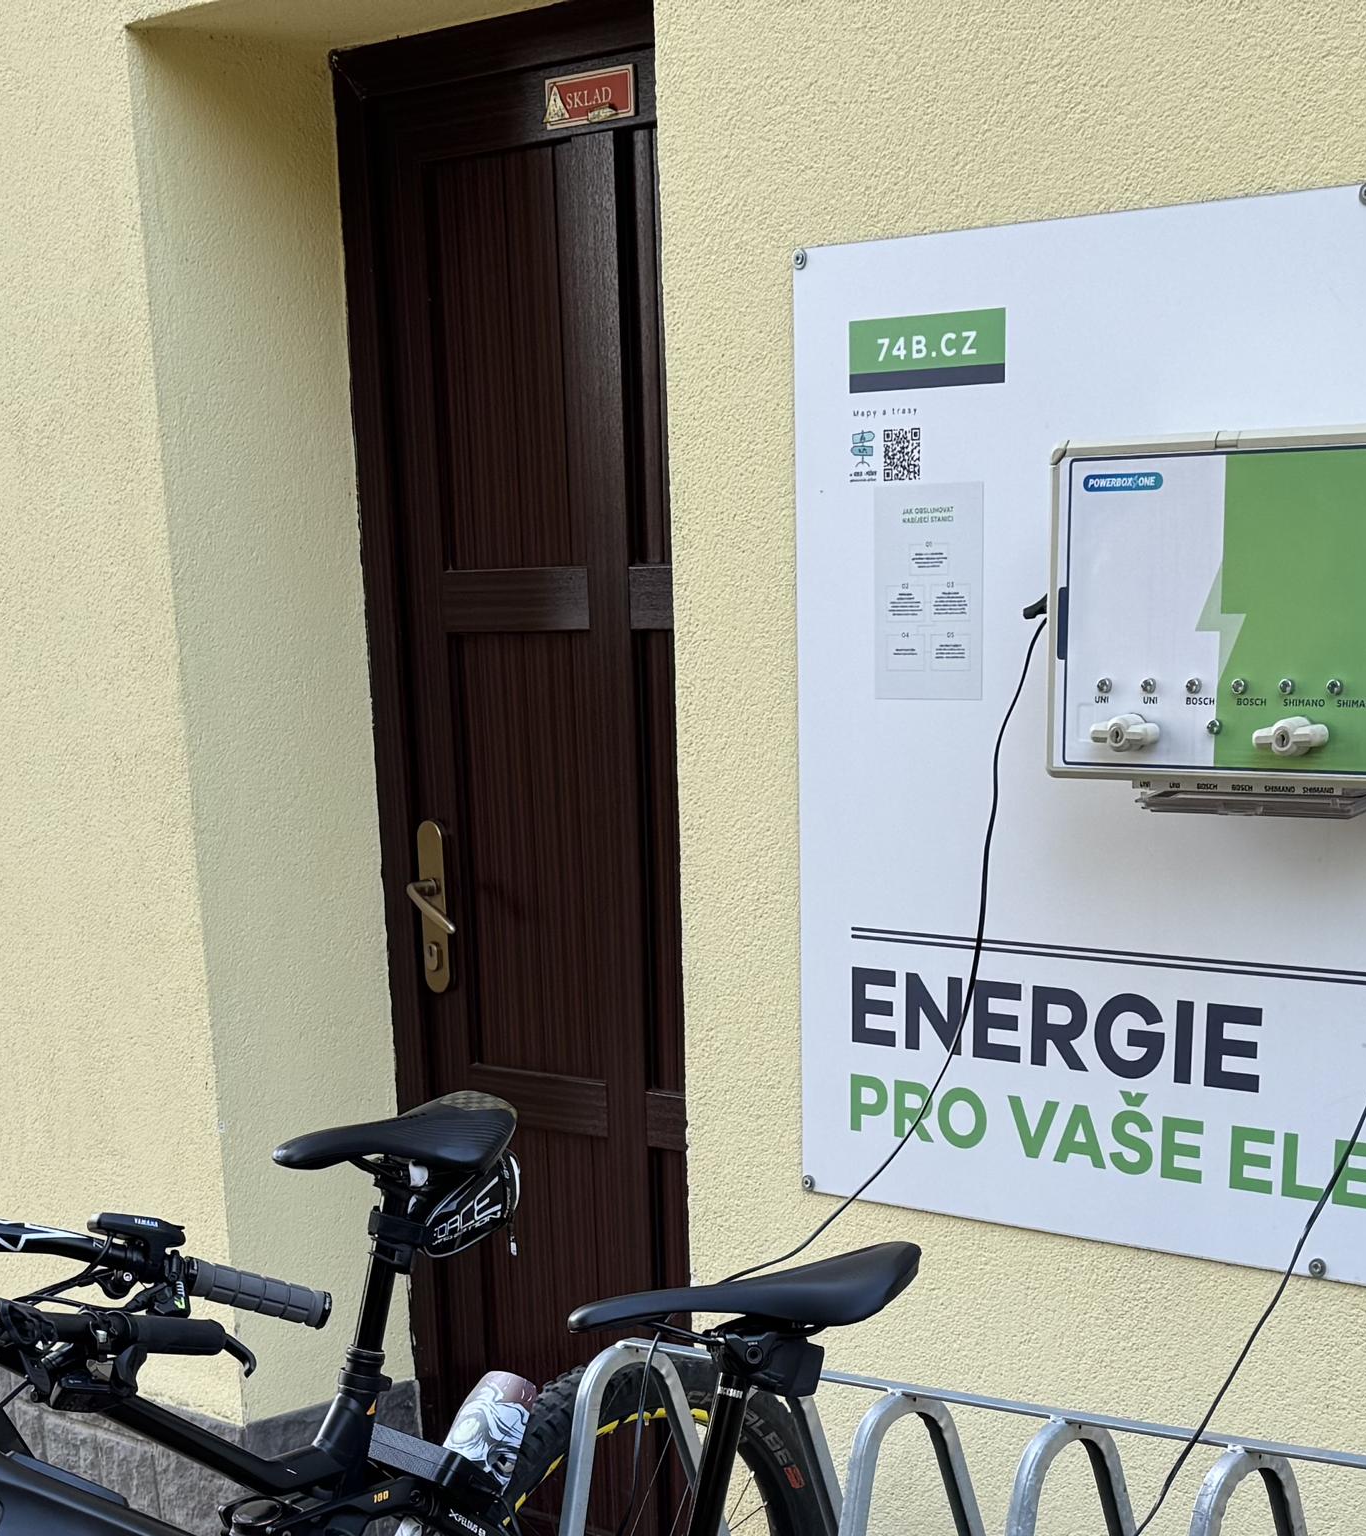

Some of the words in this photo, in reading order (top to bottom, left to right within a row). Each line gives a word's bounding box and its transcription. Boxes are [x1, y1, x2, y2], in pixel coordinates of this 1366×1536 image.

[566, 87, 612, 109] SKLAD
[877, 331, 978, 362] 74B.CZ
[853, 410, 876, 418] Mapy
[1088, 477, 1133, 488] POWERBOX
[1138, 476, 1156, 486] ONE
[1143, 697, 1158, 705] UNI
[1186, 697, 1215, 706] BOSCH
[1236, 698, 1267, 707] BOSCH
[1283, 698, 1325, 708] SHIMANO
[849, 966, 1261, 1093] ENERGIE
[849, 1073, 987, 1150] PRO
[1008, 1088, 1204, 1185] VAŠE
[134, 1217, 159, 1228] YAMAHA
